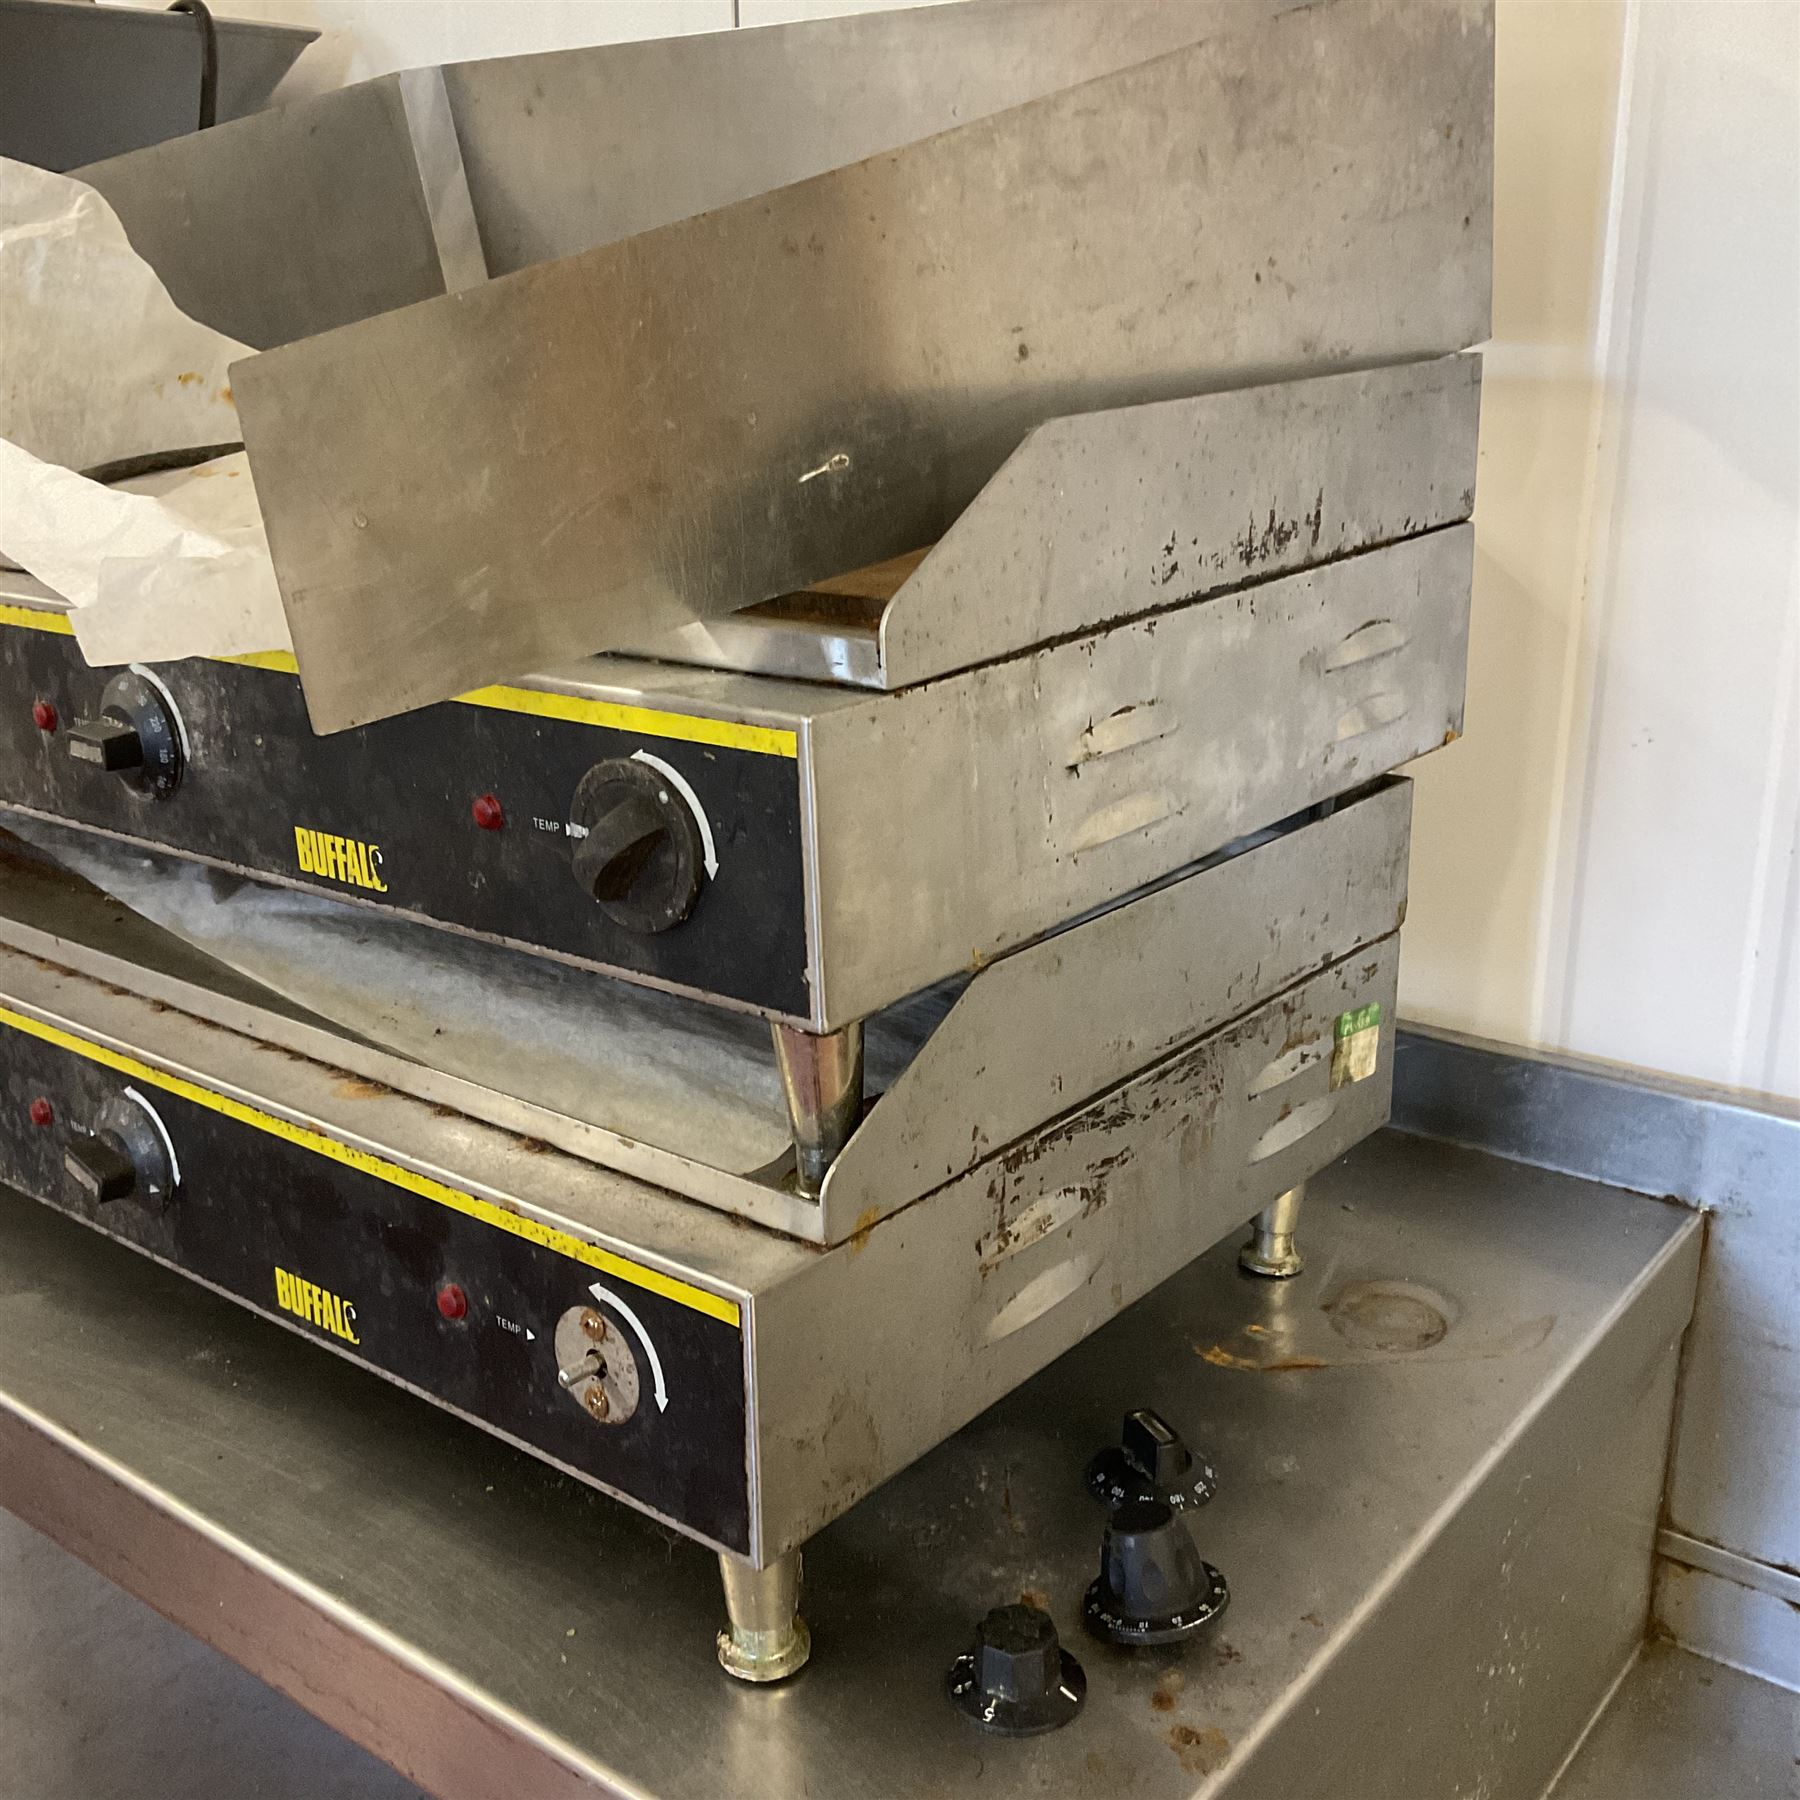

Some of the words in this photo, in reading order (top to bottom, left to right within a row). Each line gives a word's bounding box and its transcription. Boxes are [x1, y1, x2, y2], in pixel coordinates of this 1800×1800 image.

[532, 816, 560, 832] TEMP
[294, 826, 388, 893] BUFFALO
[275, 1266, 360, 1345] BUFFALO
[496, 1315, 521, 1335] TEMP
[982, 1706, 996, 1723] 5
